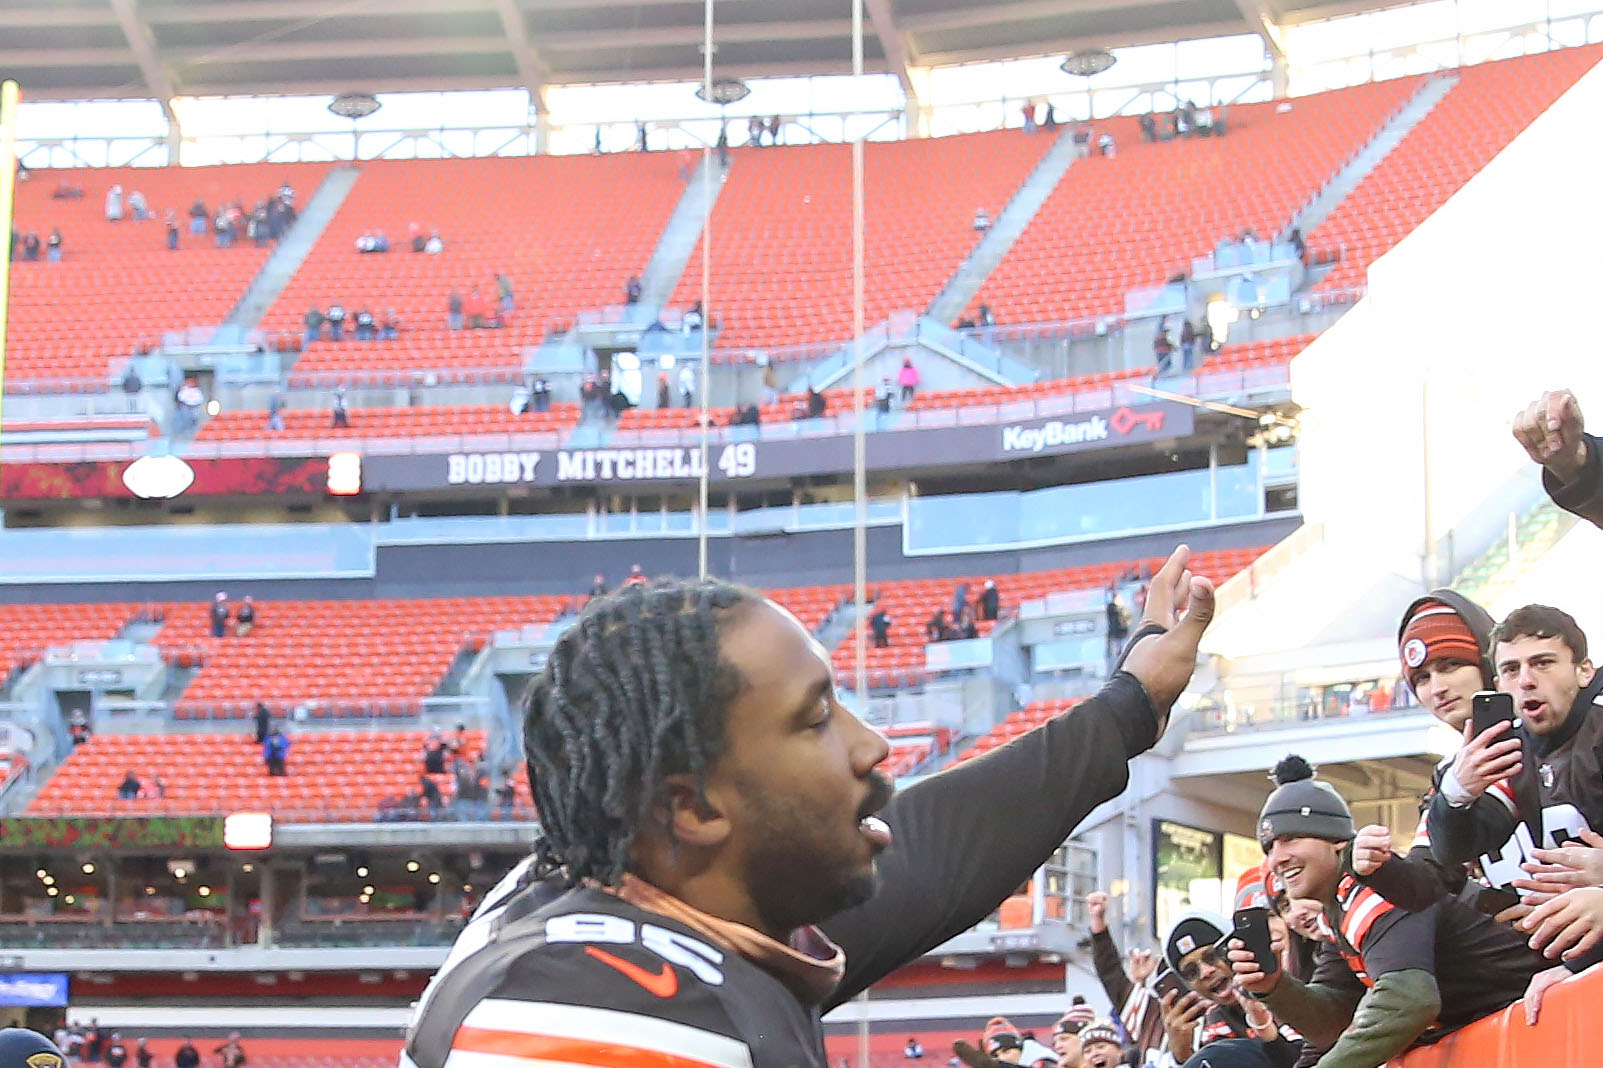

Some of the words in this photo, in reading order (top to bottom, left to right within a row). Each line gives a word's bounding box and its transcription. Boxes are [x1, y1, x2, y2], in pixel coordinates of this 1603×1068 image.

[1002, 415, 1108, 451] KeyBank
[447, 451, 541, 484] BOBBY
[556, 448, 708, 481] MITCHELL
[718, 442, 756, 477] 49
